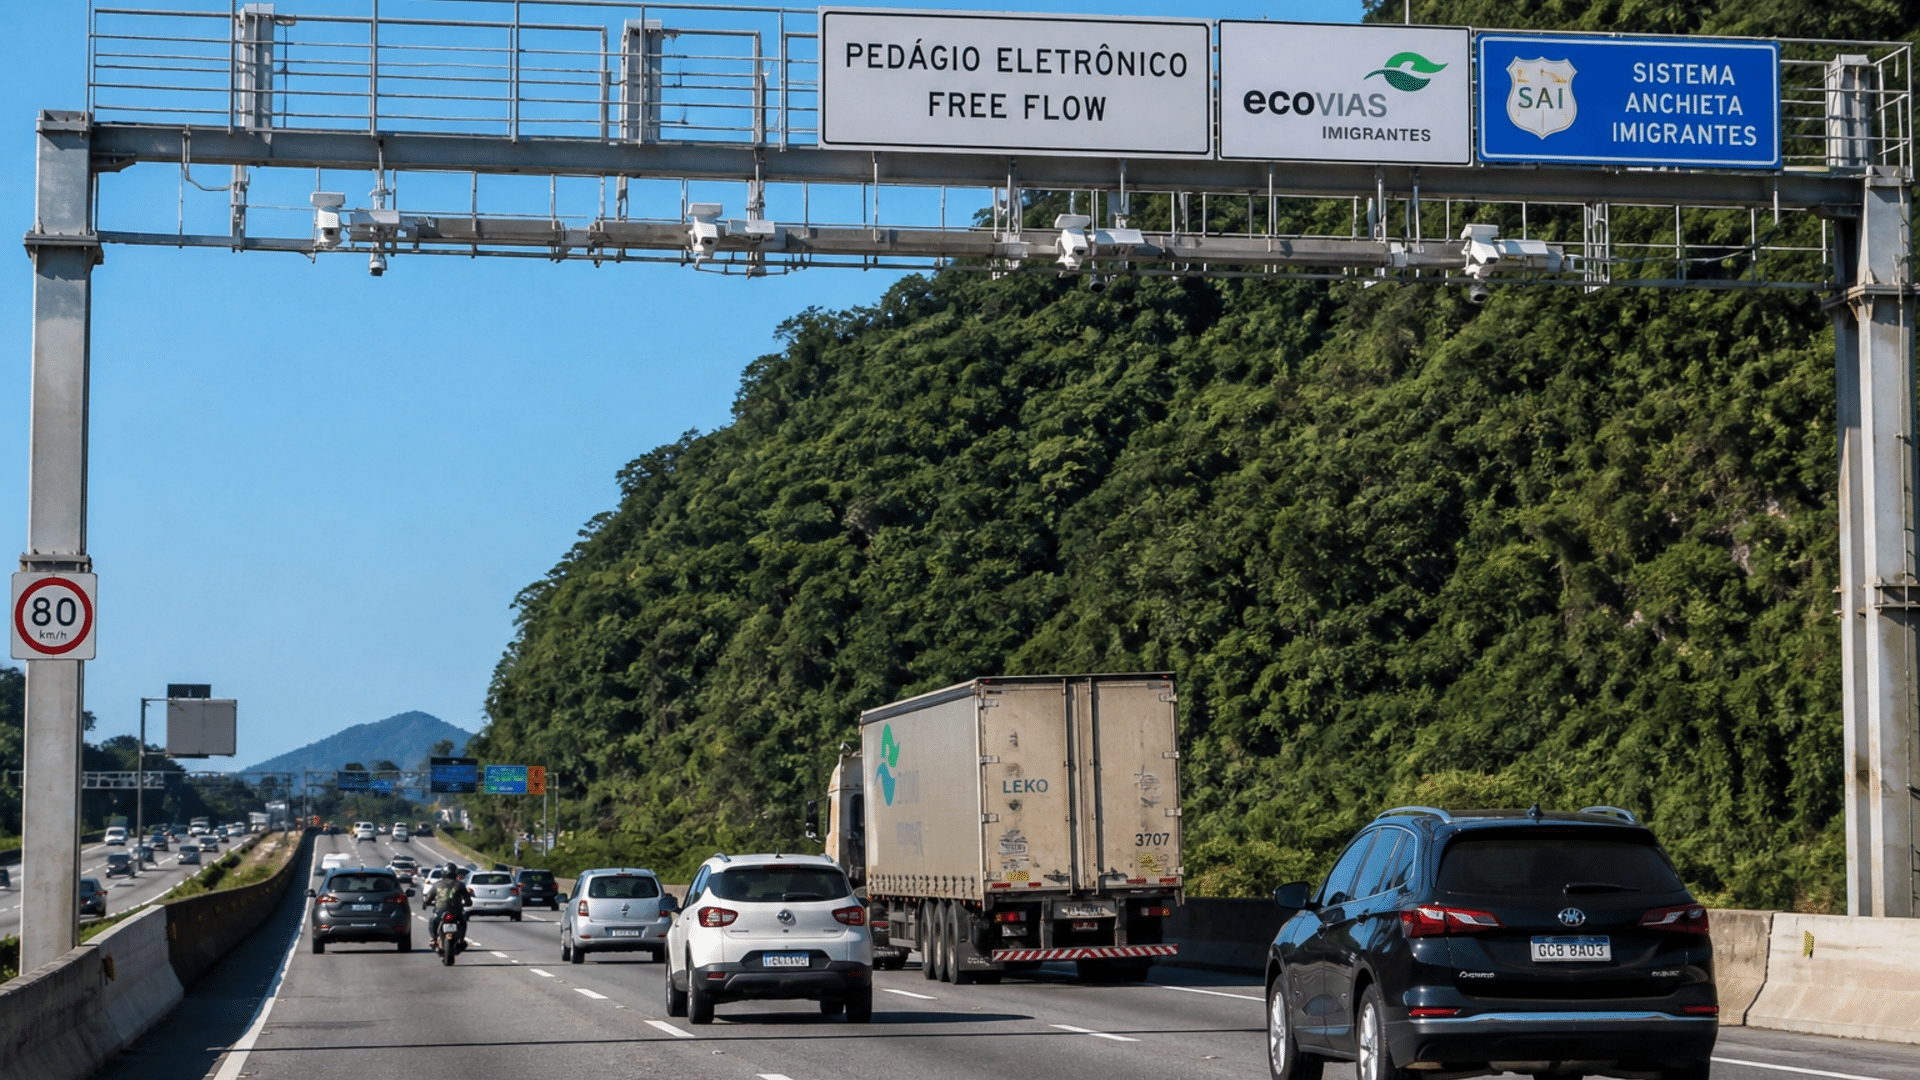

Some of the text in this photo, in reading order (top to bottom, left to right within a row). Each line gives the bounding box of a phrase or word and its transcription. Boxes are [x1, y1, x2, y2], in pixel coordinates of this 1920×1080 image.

[846, 37, 1187, 78] PEDÁGIO ELETRÔNICO
[1633, 62, 1736, 86] SISTEMA
[929, 91, 1107, 122] FREE FLOW
[1518, 86, 1563, 109] SAI
[1624, 92, 1744, 116] ANCHIETA
[1322, 125, 1431, 142] IMIGRANTES
[1612, 121, 1757, 147] IMIGRANTES
[32, 597, 76, 626] 80
[39, 629, 67, 641] km/h
[1002, 778, 1049, 794] LEKO
[1135, 832, 1170, 847] 3707
